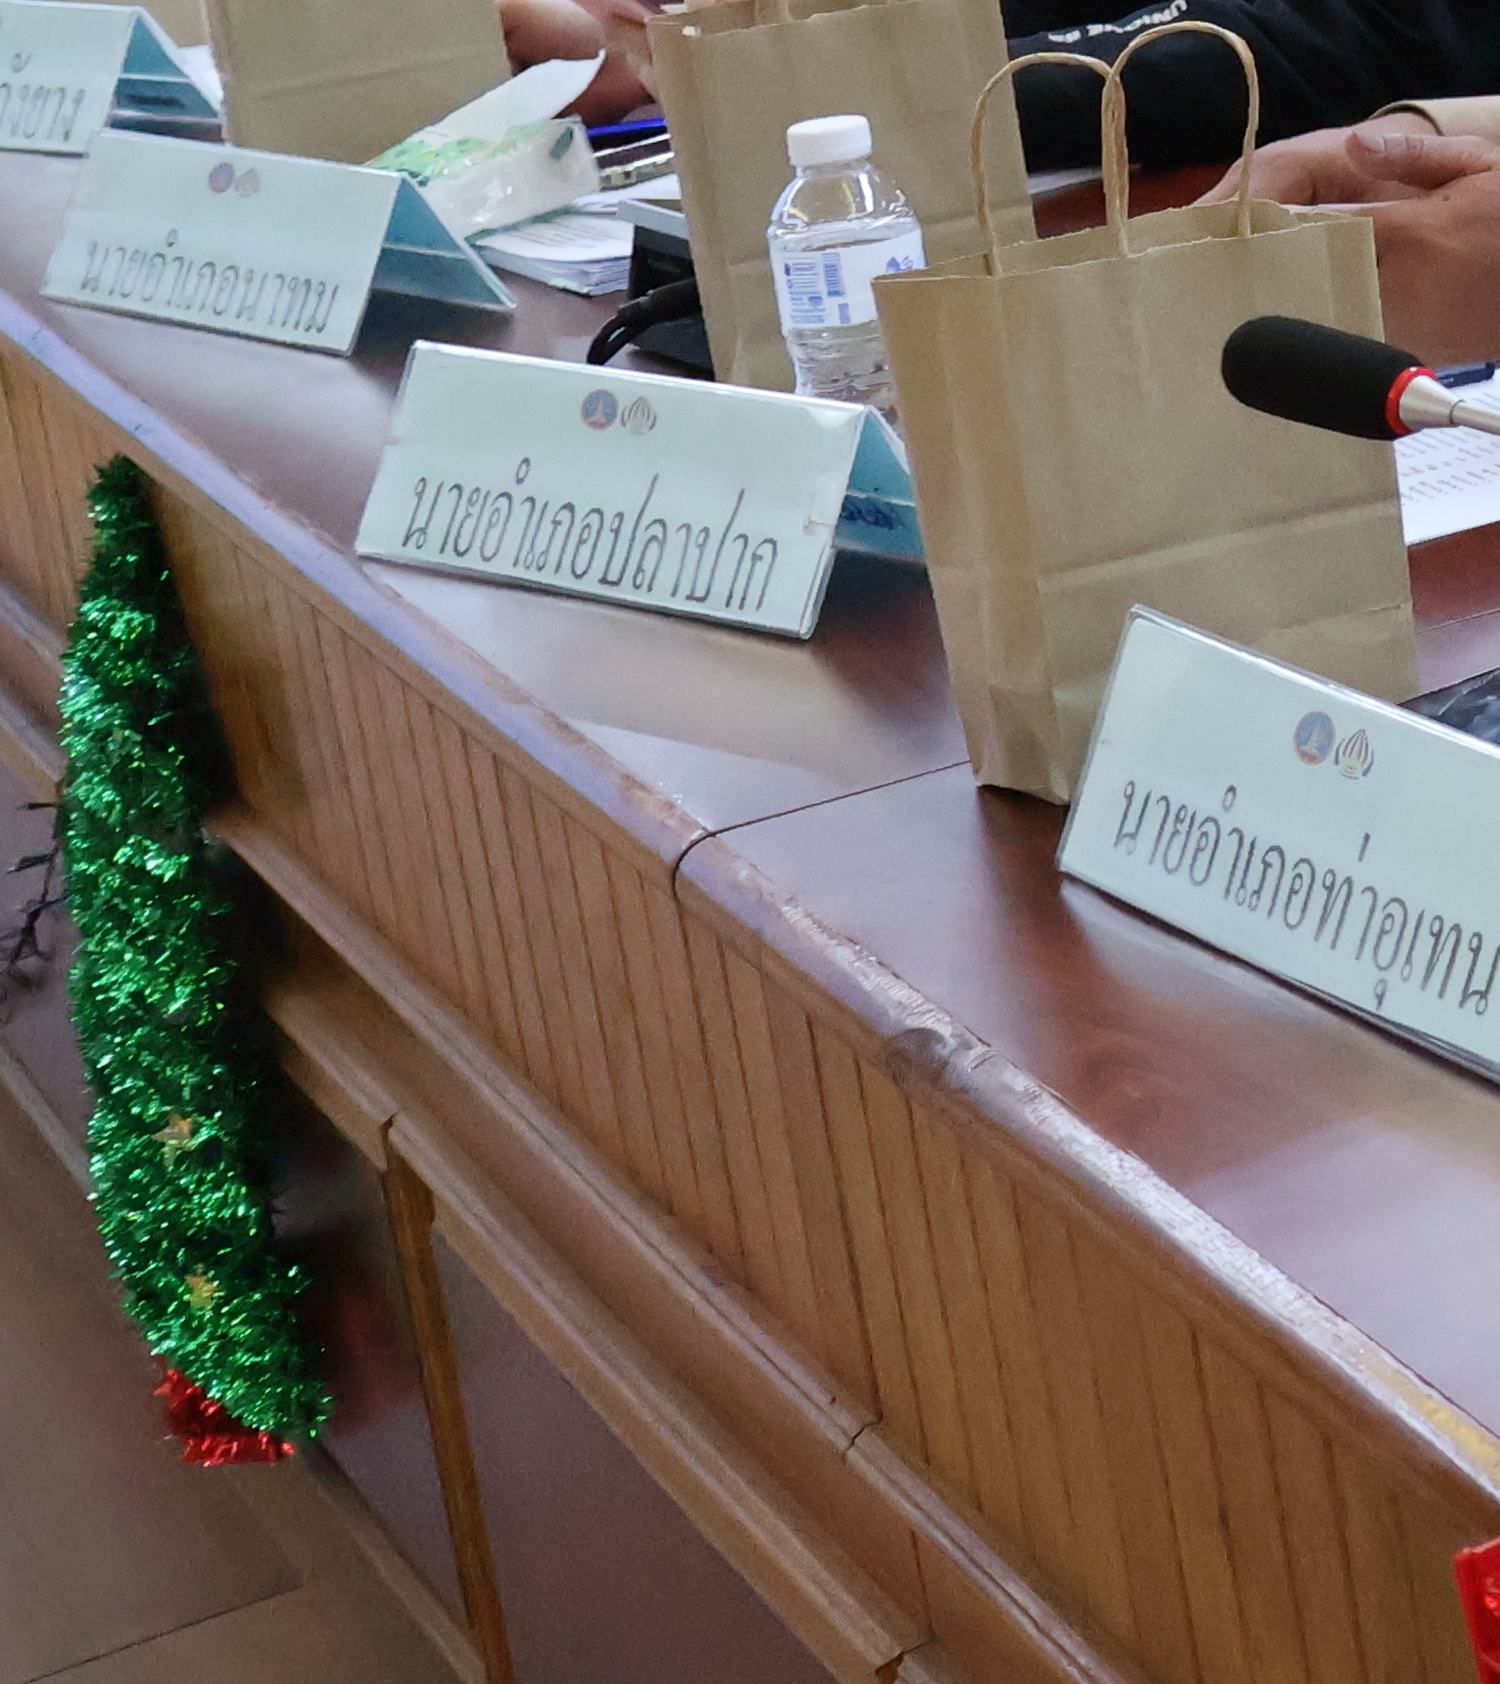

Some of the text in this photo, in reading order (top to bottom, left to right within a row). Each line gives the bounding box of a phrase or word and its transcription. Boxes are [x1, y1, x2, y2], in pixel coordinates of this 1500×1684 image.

[80, 227, 337, 337] นายอำเภอนาทม
[401, 456, 780, 614] นายอำเภอปลาปาก
